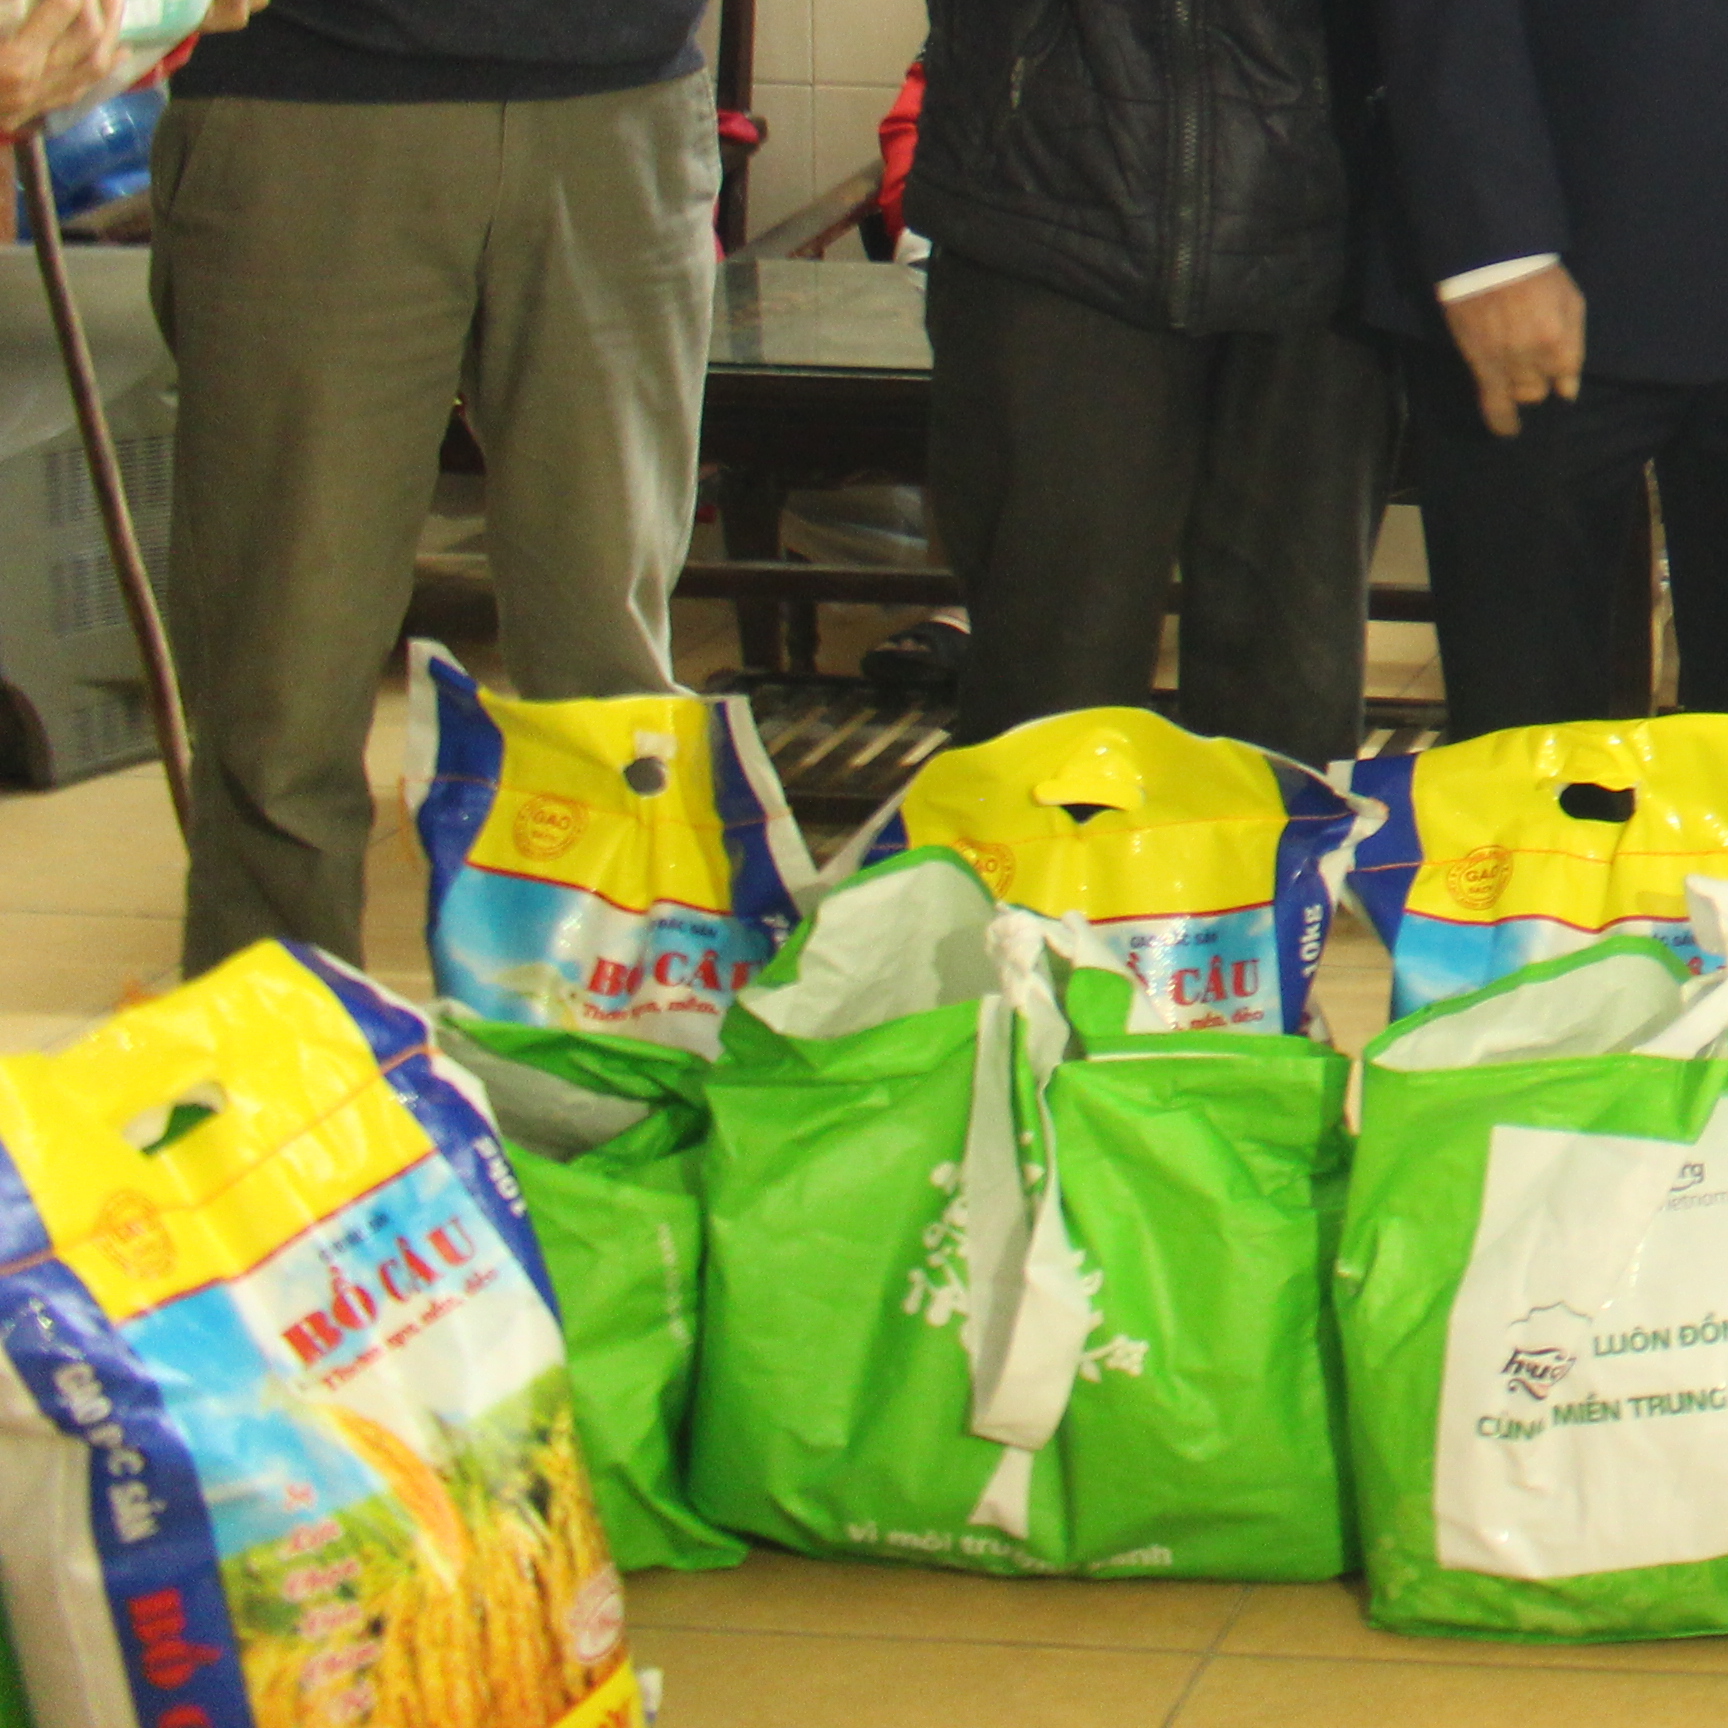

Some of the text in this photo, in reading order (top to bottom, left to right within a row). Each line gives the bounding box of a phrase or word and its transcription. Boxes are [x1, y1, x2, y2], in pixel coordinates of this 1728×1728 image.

[1301, 902, 1325, 979] 10kg
[1169, 954, 1260, 1006] CÂU
[1593, 1326, 1672, 1358] LUÔN
[1476, 1410, 1547, 1442] CÙN
[1551, 1393, 1622, 1427] MIỀN
[1627, 1386, 1727, 1419] TRUNG
